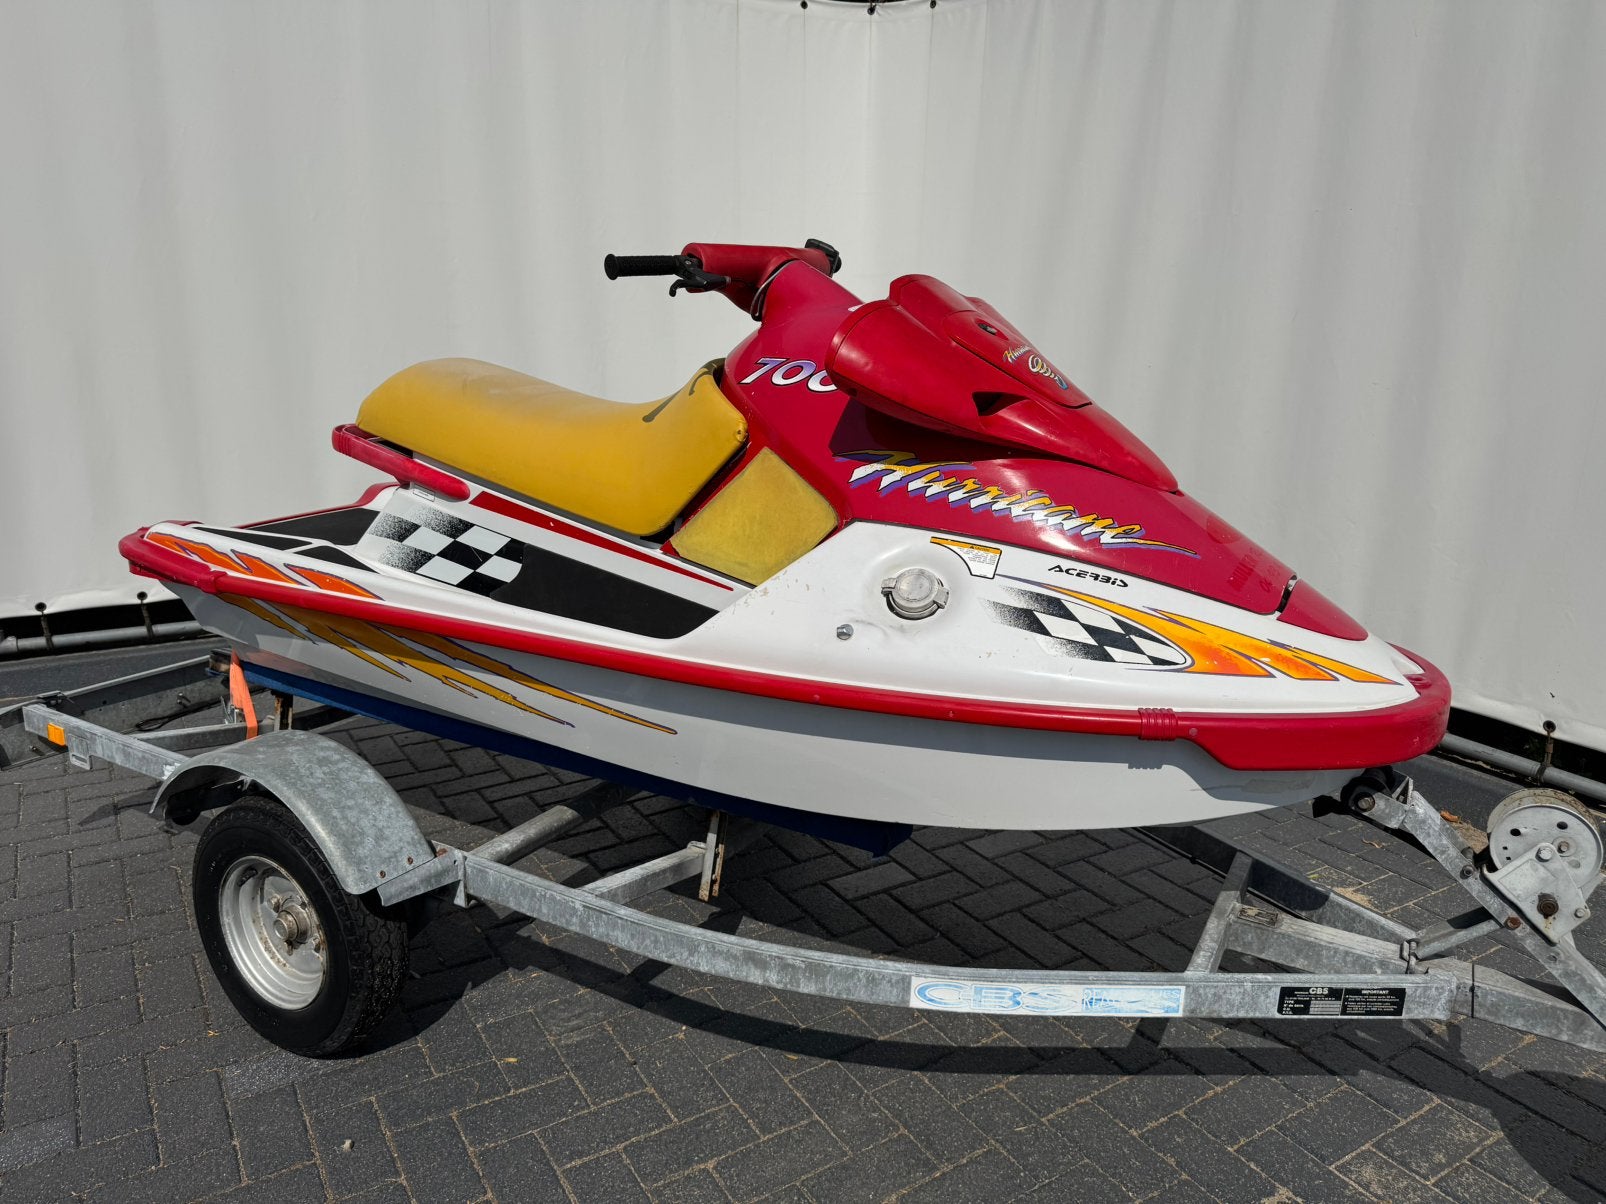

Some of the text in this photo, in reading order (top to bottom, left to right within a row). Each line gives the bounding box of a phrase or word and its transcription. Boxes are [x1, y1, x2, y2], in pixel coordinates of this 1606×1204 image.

[832, 449, 1201, 560] Hurricane
[1048, 564, 1129, 588] ACERBIS
[914, 981, 1078, 1013] CBS
[1309, 987, 1329, 995] CBS
